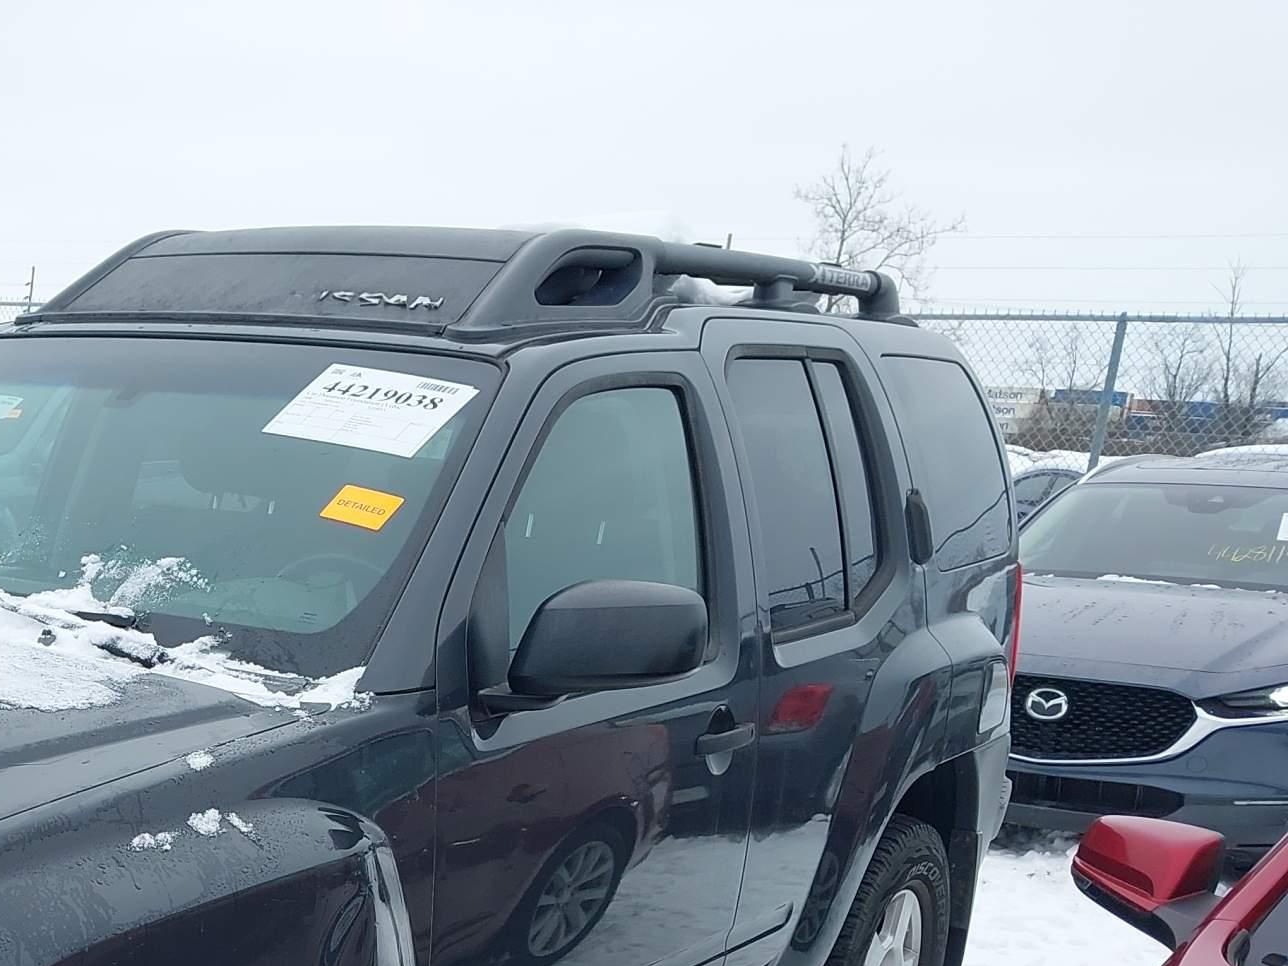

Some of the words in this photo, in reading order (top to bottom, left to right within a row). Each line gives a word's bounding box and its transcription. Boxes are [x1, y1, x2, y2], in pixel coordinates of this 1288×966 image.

[316, 288, 446, 311] ISSAN
[322, 380, 444, 411] 44219038
[336, 498, 386, 517] DETAILED
